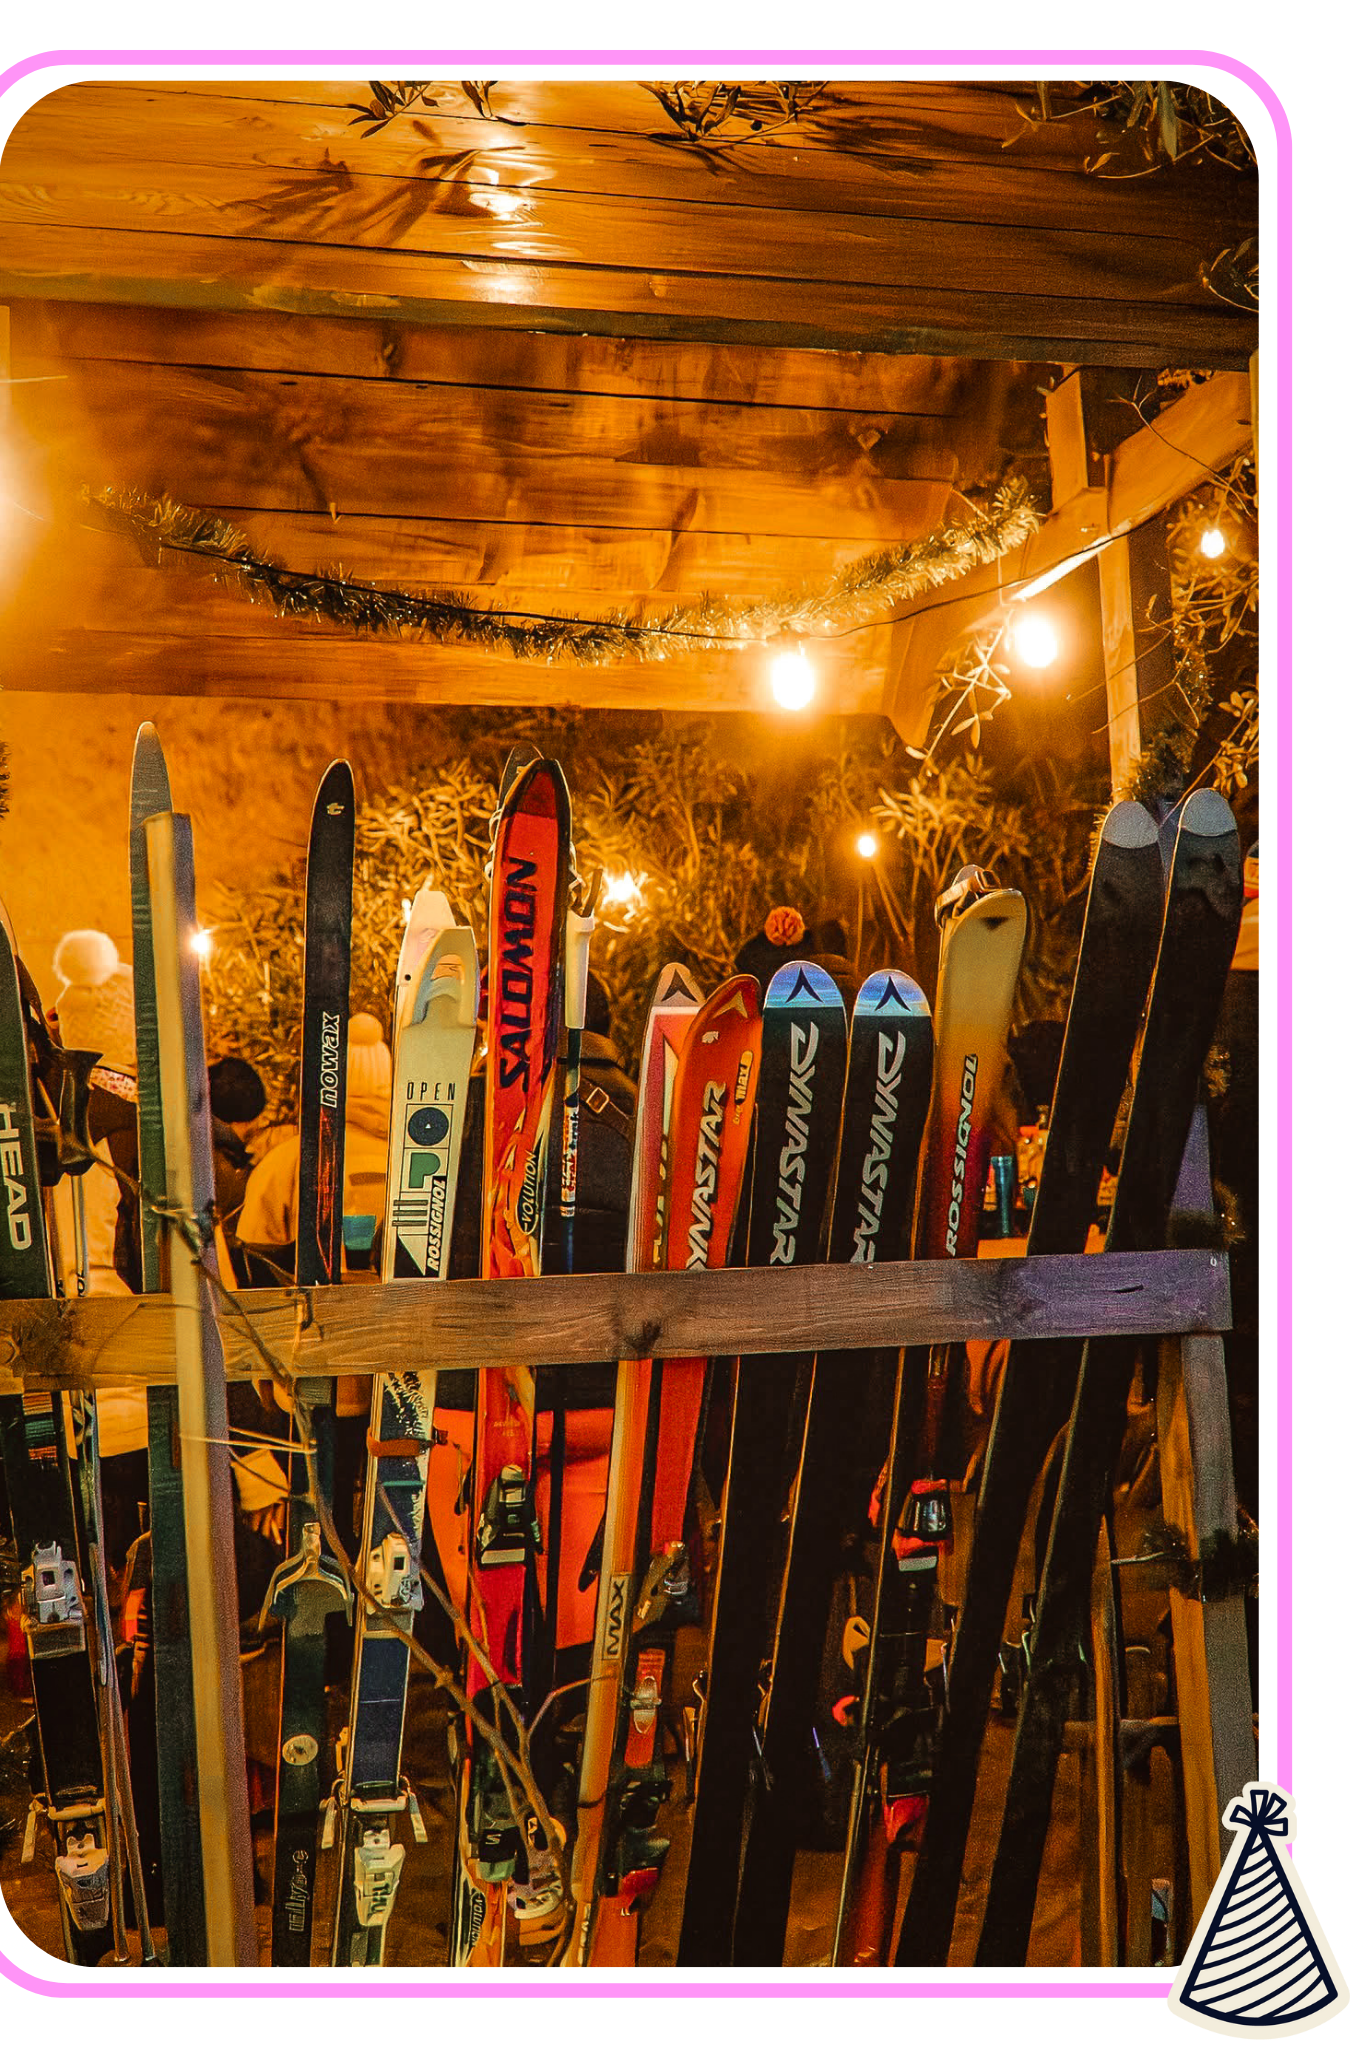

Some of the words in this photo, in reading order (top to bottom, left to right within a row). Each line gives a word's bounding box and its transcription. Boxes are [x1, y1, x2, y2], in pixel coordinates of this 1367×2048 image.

[499, 857, 538, 1093] SALOMON
[320, 1011, 341, 1109] nowax
[406, 1082, 457, 1101] OPEN
[769, 1021, 819, 1265] DYNASTAR
[0, 1102, 33, 1251] HEAD
[426, 1179, 447, 1272] ROSSIGNOL
[685, 1080, 727, 1270] YNASTAR
[851, 1030, 905, 1263] DYNASTAR
[945, 1053, 979, 1257] ROSSIGNOL
[607, 1580, 625, 1655] MAX
